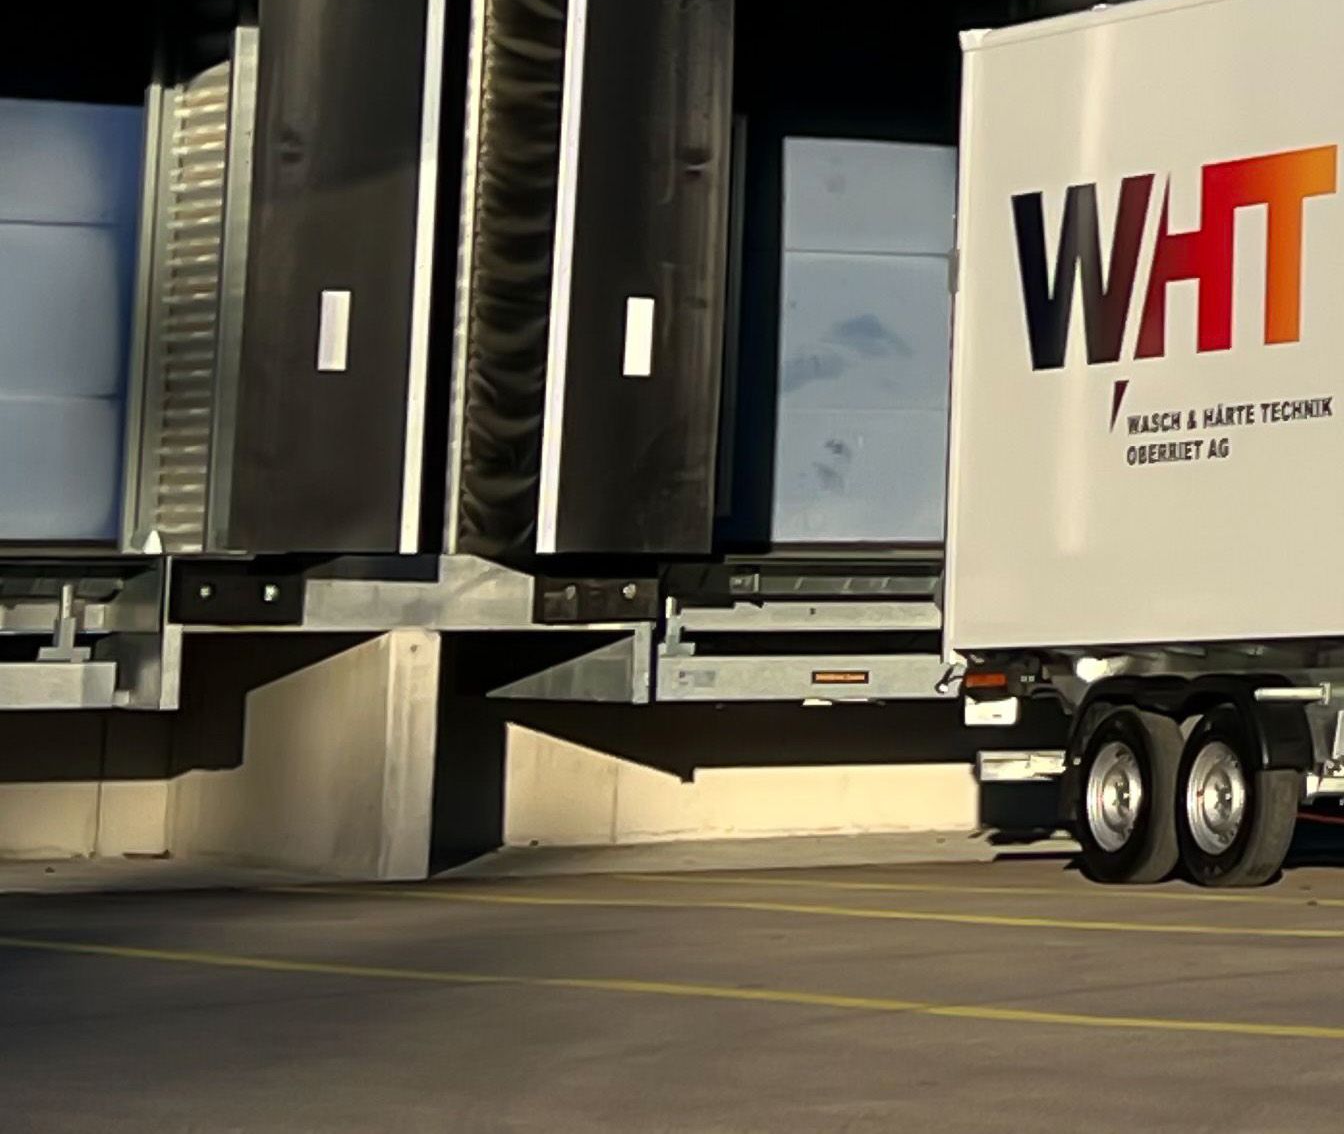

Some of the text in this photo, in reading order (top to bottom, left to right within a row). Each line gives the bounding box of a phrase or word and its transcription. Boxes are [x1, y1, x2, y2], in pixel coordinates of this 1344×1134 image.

[1011, 144, 1337, 371] WHT
[1127, 396, 1333, 435] WASCH & HÄRTE TECHNIK
[1127, 438, 1229, 466] OBERRIET AG
